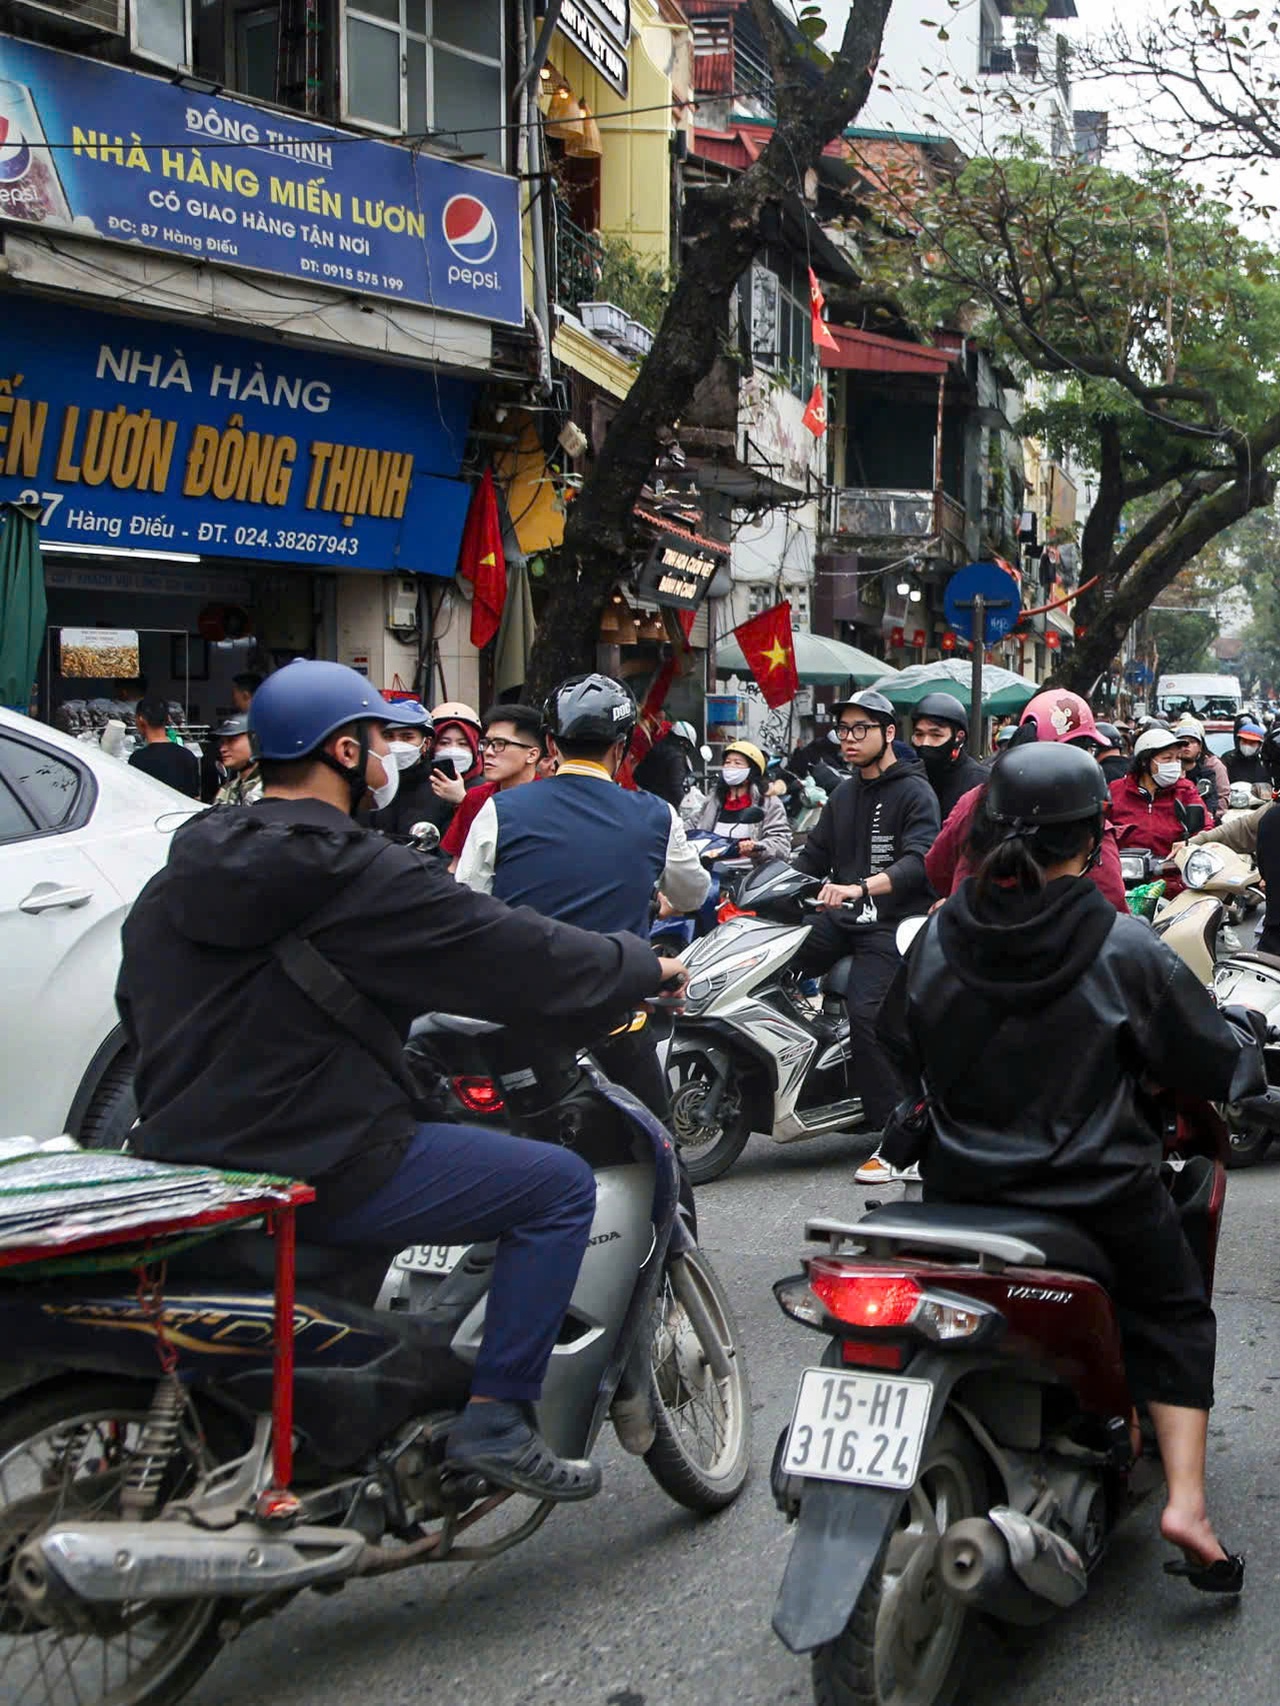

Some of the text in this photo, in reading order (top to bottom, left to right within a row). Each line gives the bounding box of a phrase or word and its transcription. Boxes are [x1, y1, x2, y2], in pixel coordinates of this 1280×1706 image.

[186, 107, 334, 166] ĐÔNG THỊNH
[0, 185, 38, 206] epsi
[71, 126, 425, 239] NHÀ HÀNG MIẾN LƯƠN
[108, 216, 238, 256] ĐC: 87 Hàng Điếu
[149, 190, 370, 256] CÓ GIAO HÀNG TẬN NƠI
[300, 258, 404, 291] ĐT: 0915 575 199
[448, 265, 499, 291] pepsi
[96, 344, 331, 413] NHÀ HÀNG
[56, 404, 177, 493] LƯƠN
[183, 413, 297, 506] ĐÔNG
[305, 440, 414, 527] THỊNH
[67, 508, 122, 538] Hàng
[130, 513, 174, 539] Điếu
[198, 522, 229, 545] ĐT.
[235, 526, 359, 557] 024.38267943
[820, 1378, 909, 1430] 15-H1
[791, 1424, 909, 1481] 316.24
